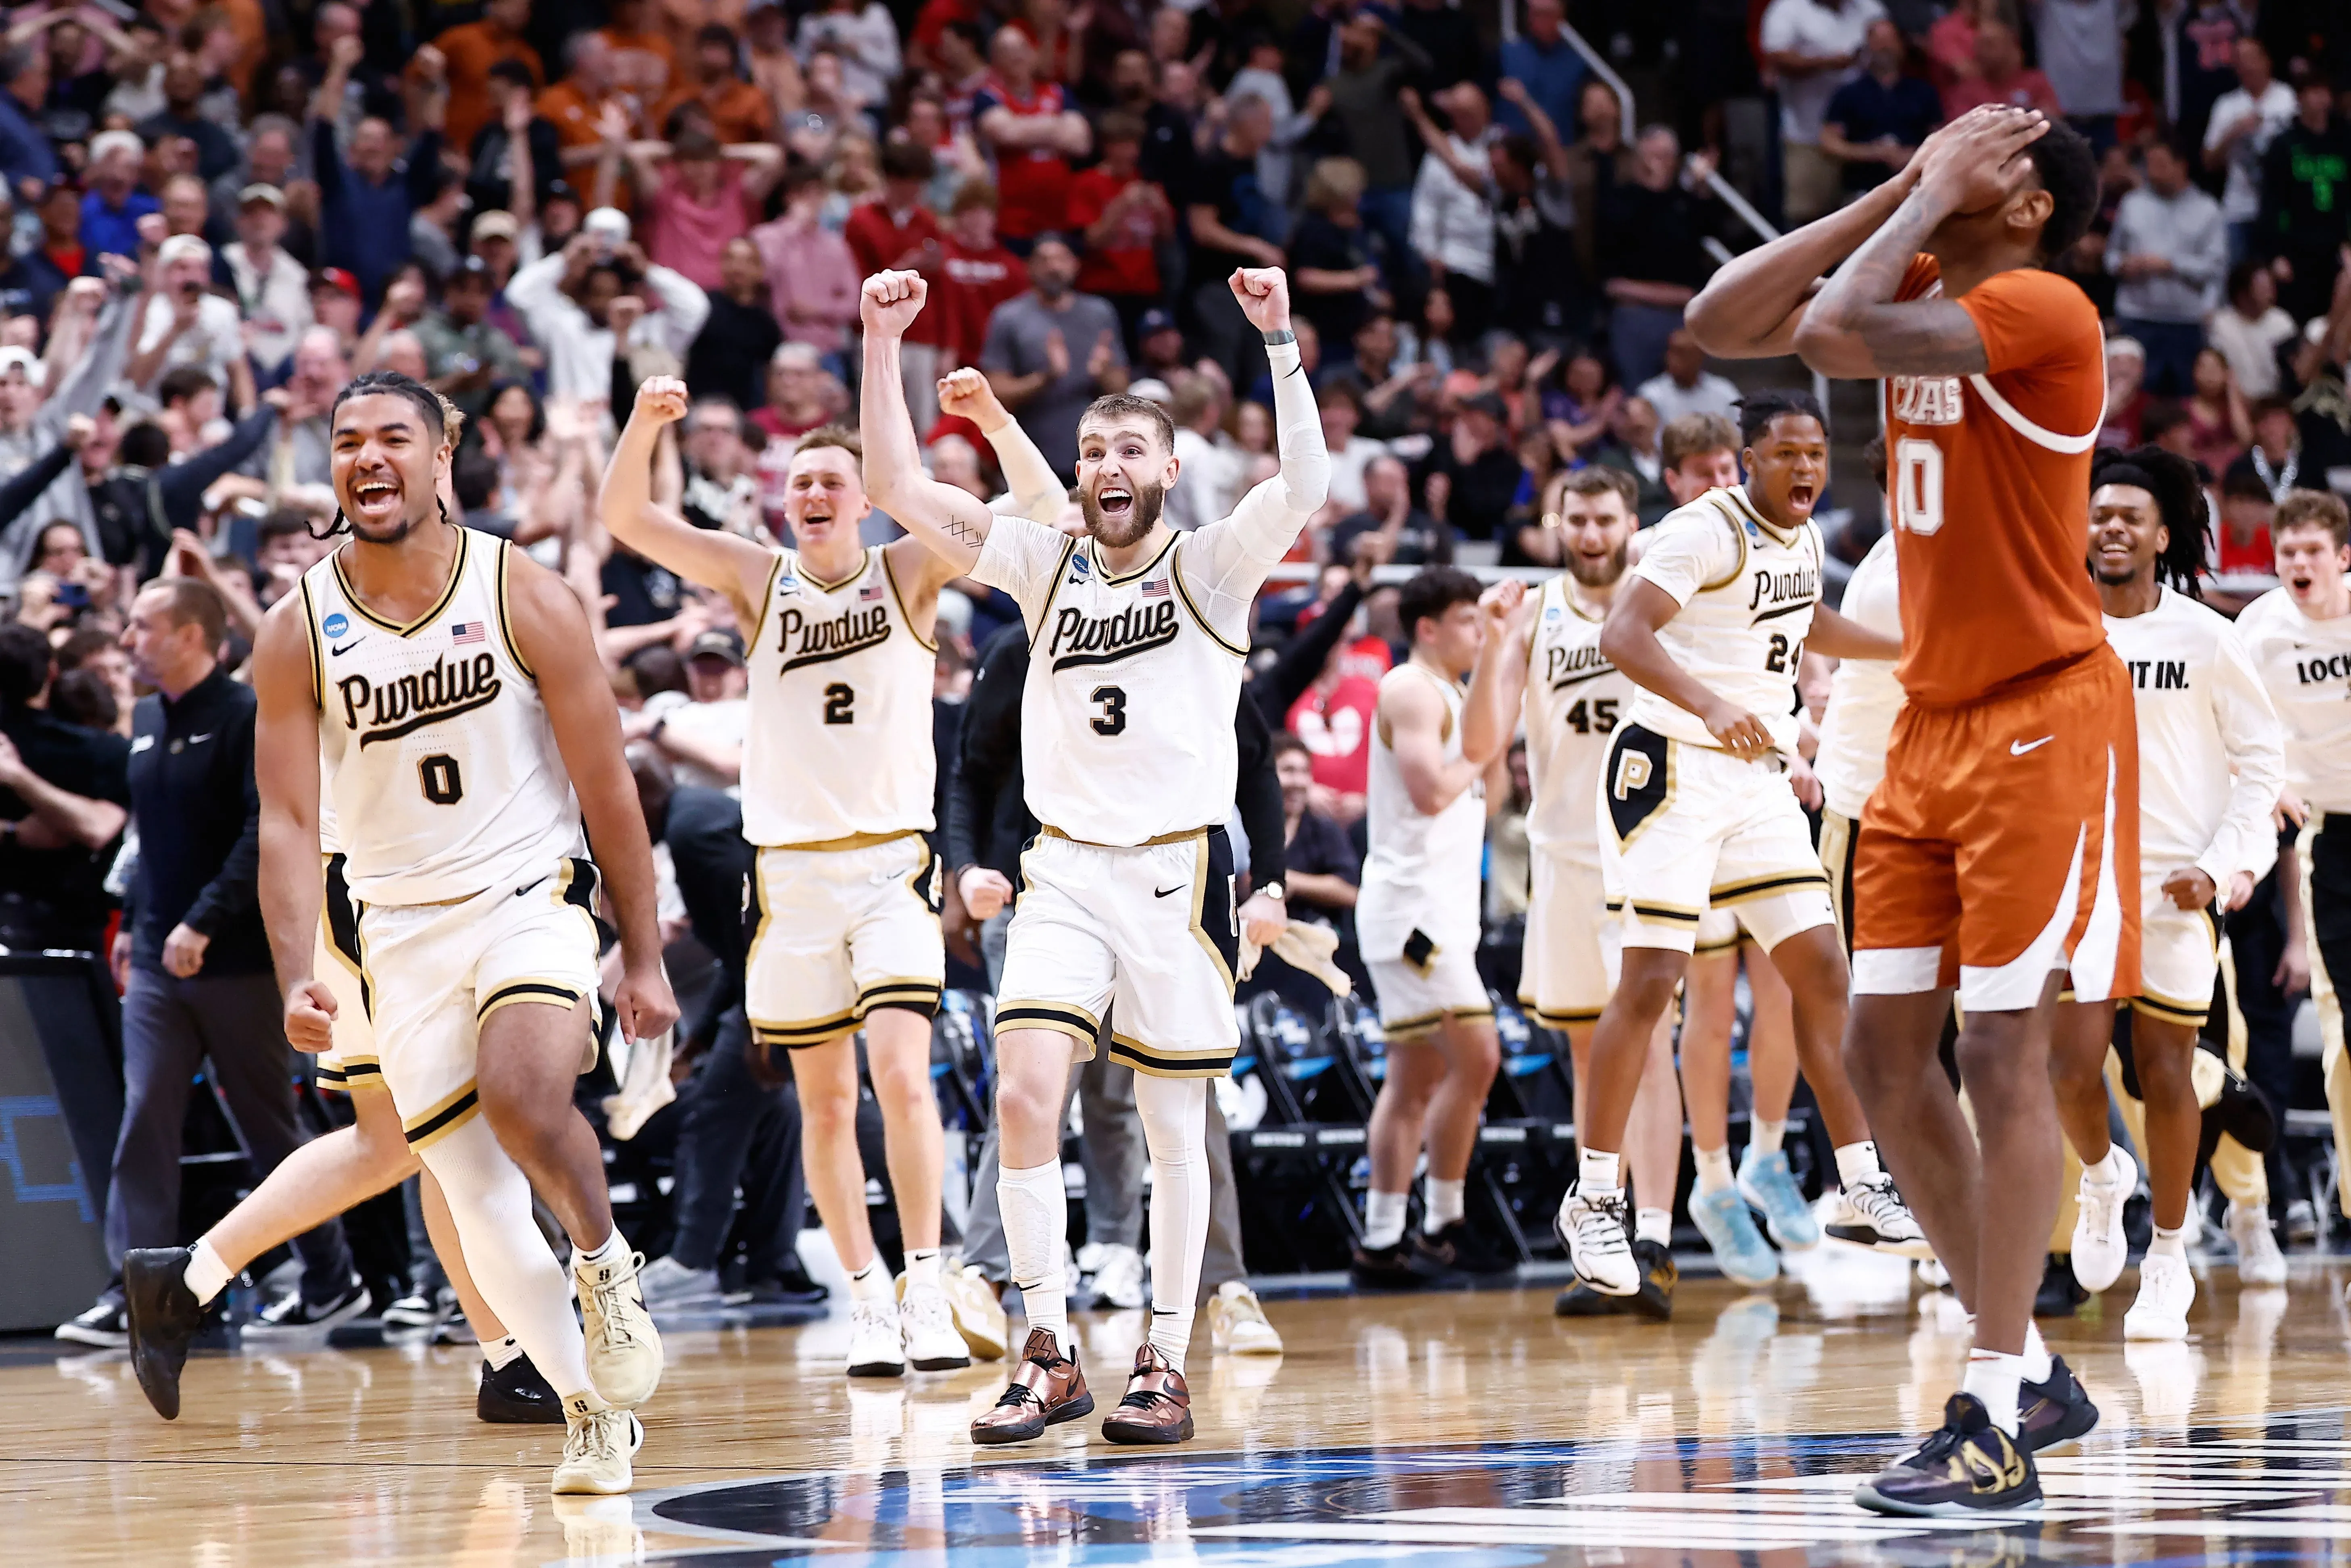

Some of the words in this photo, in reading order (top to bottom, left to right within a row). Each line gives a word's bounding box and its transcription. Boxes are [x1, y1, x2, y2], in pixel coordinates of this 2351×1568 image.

[1895, 434, 1944, 536] 10
[1073, 559, 1088, 572] NCAA
[778, 605, 892, 655] Purdue
[1049, 600, 1180, 658] Purdue
[336, 652, 502, 731] Purdue
[2155, 661, 2189, 689] IN.
[823, 682, 854, 725] 2
[1090, 685, 1127, 736] 3
[1566, 699, 1619, 733] 45
[416, 753, 464, 805] 0
[1614, 747, 1653, 801] P
